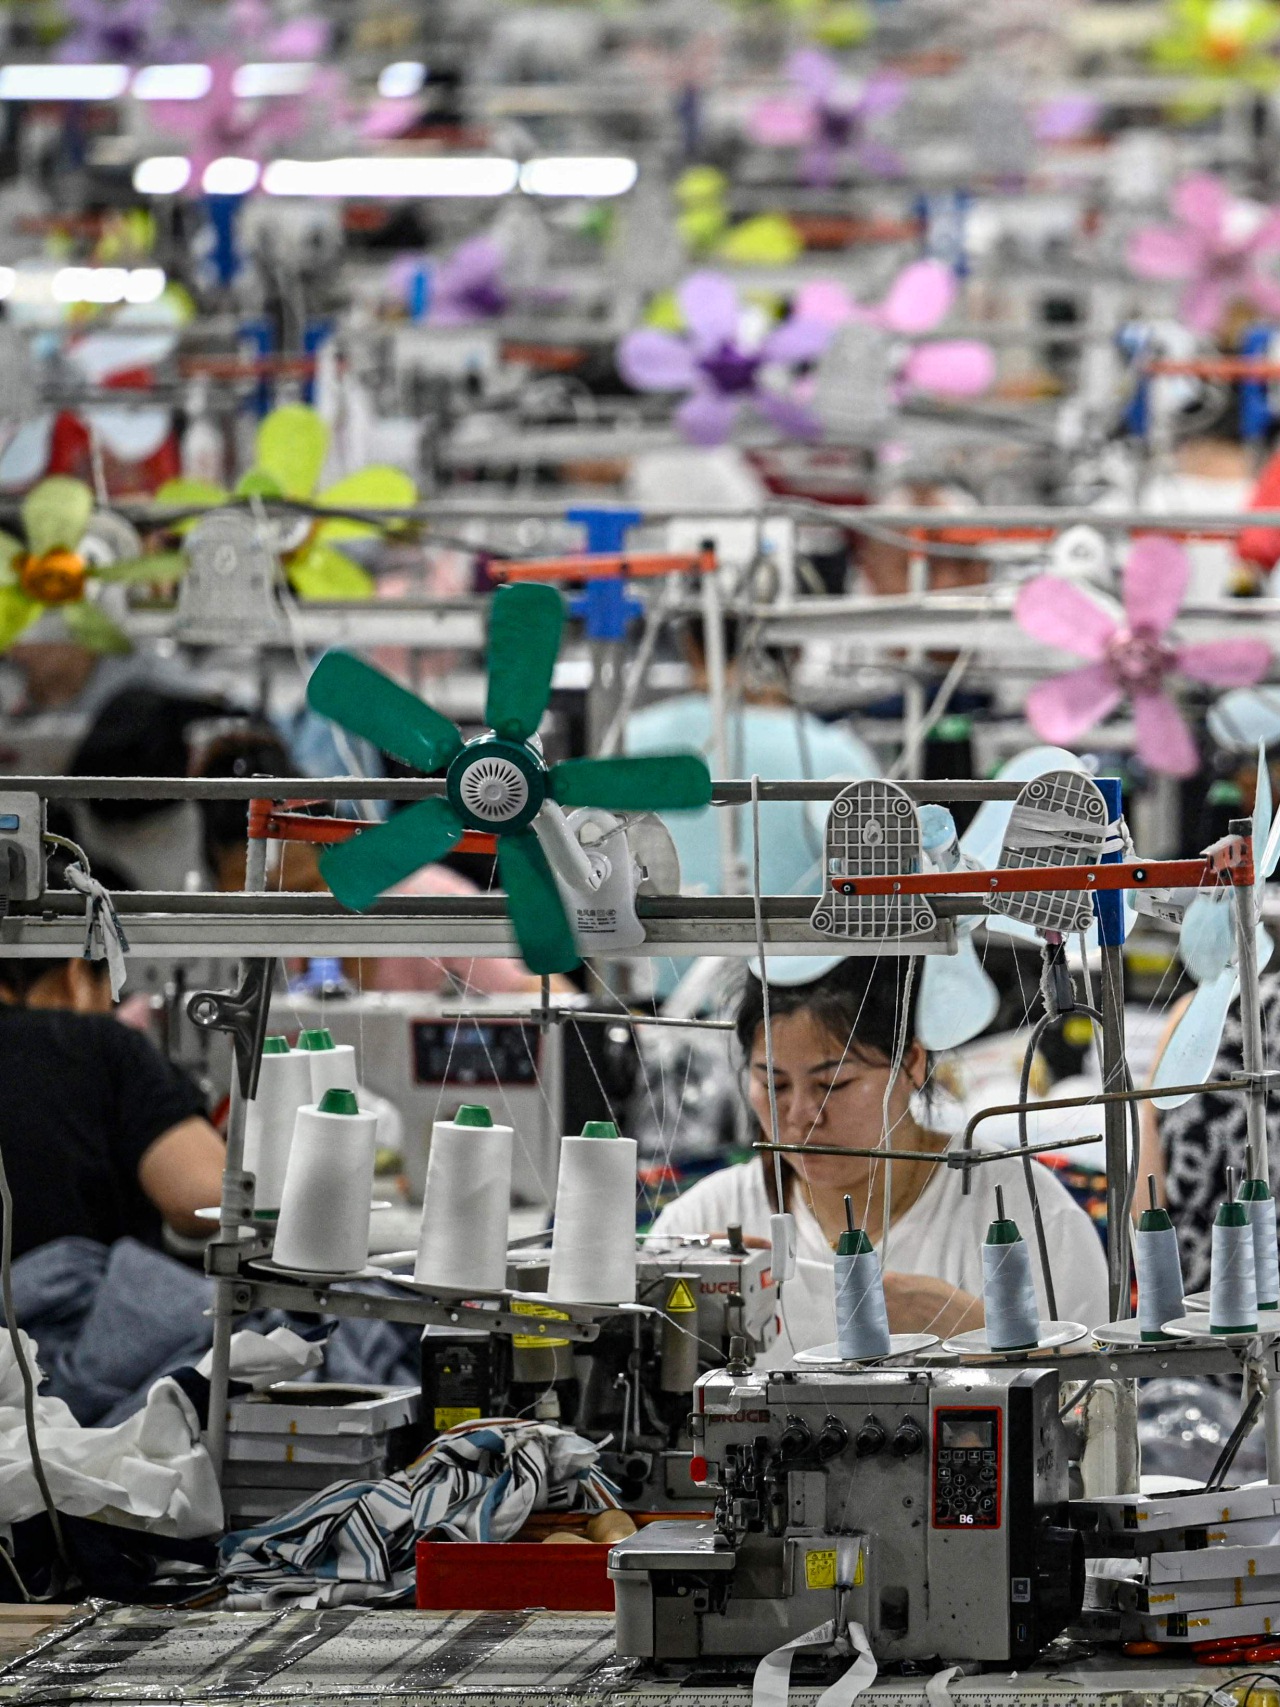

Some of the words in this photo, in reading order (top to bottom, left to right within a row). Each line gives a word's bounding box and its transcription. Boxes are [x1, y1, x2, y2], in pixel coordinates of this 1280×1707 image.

[699, 1281, 739, 1294] RUCE
[709, 1409, 771, 1423] BRUCE
[959, 1514, 974, 1524] B6
